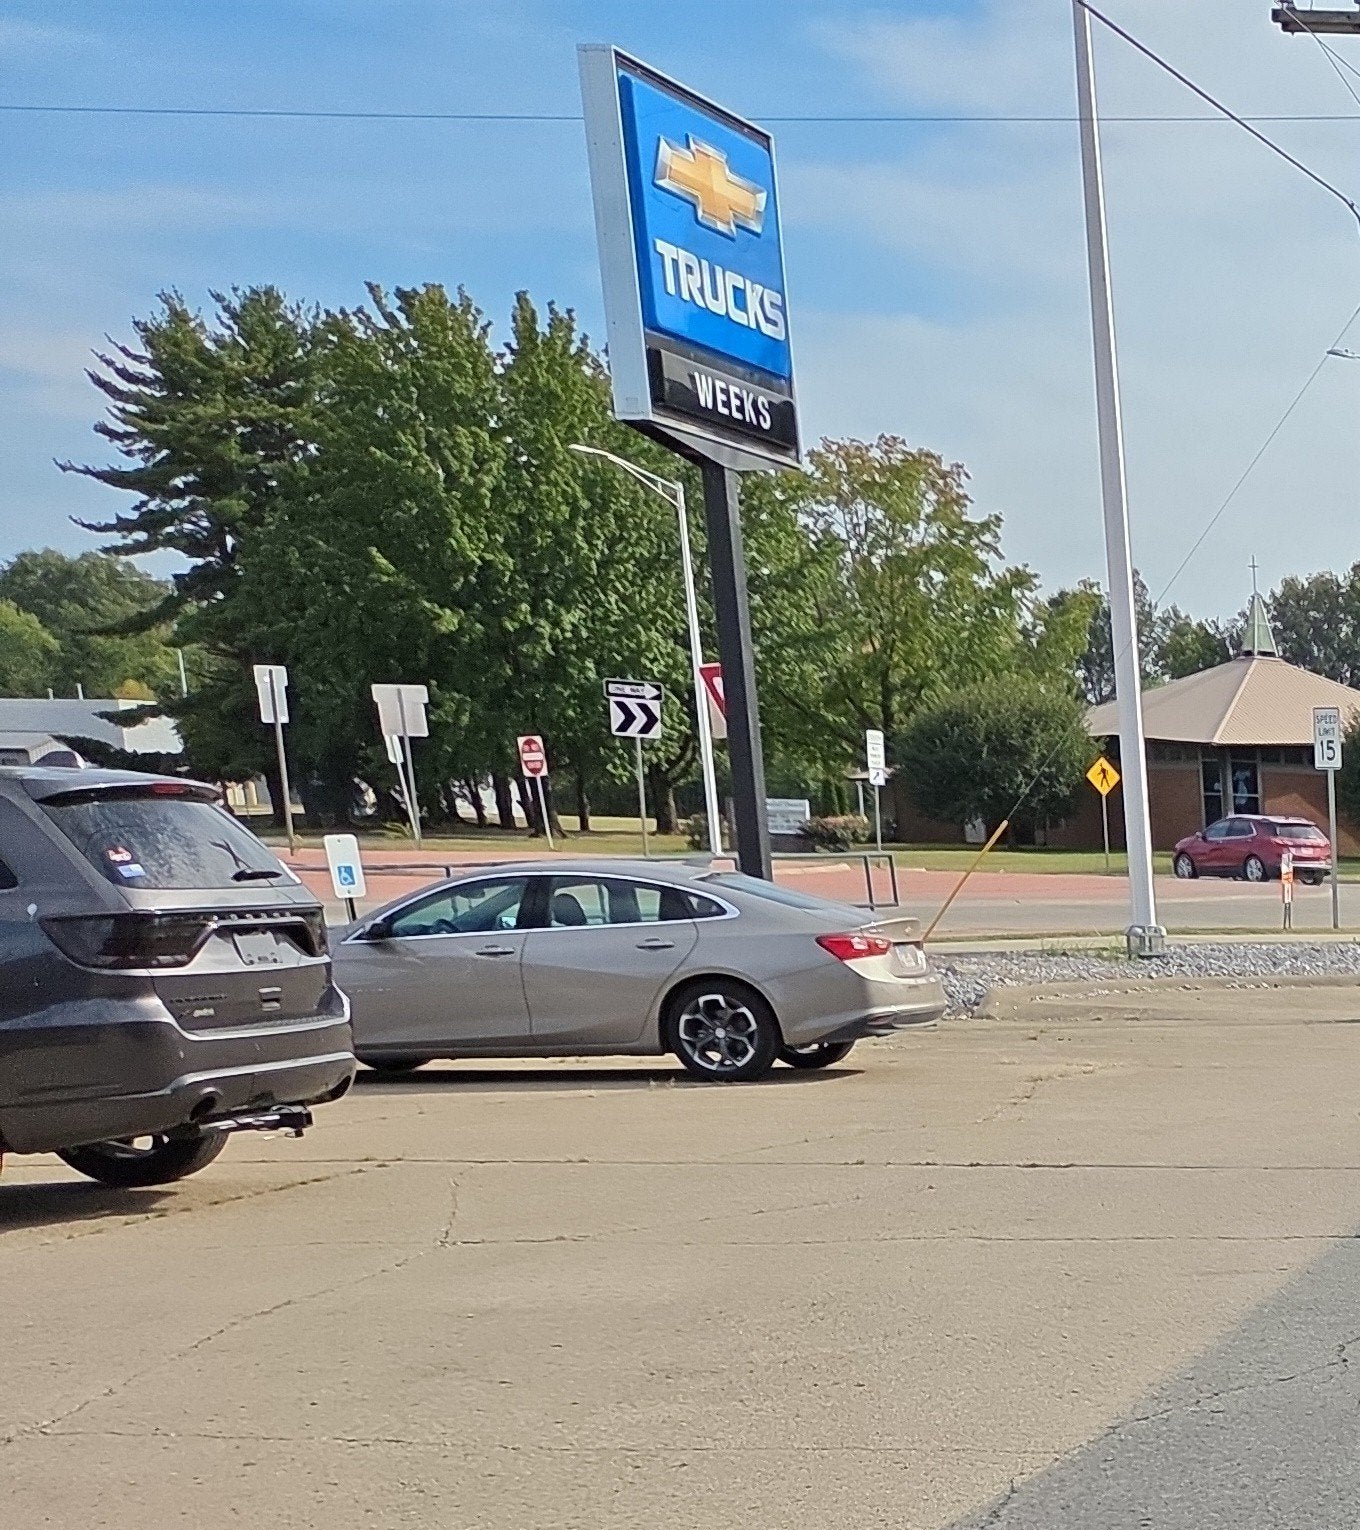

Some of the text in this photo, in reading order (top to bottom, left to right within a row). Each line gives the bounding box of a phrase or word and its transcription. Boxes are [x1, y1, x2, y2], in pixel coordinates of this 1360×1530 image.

[655, 239, 785, 340] TRUCKS
[693, 371, 772, 430] WEEKS
[1320, 739, 1336, 761] 15
